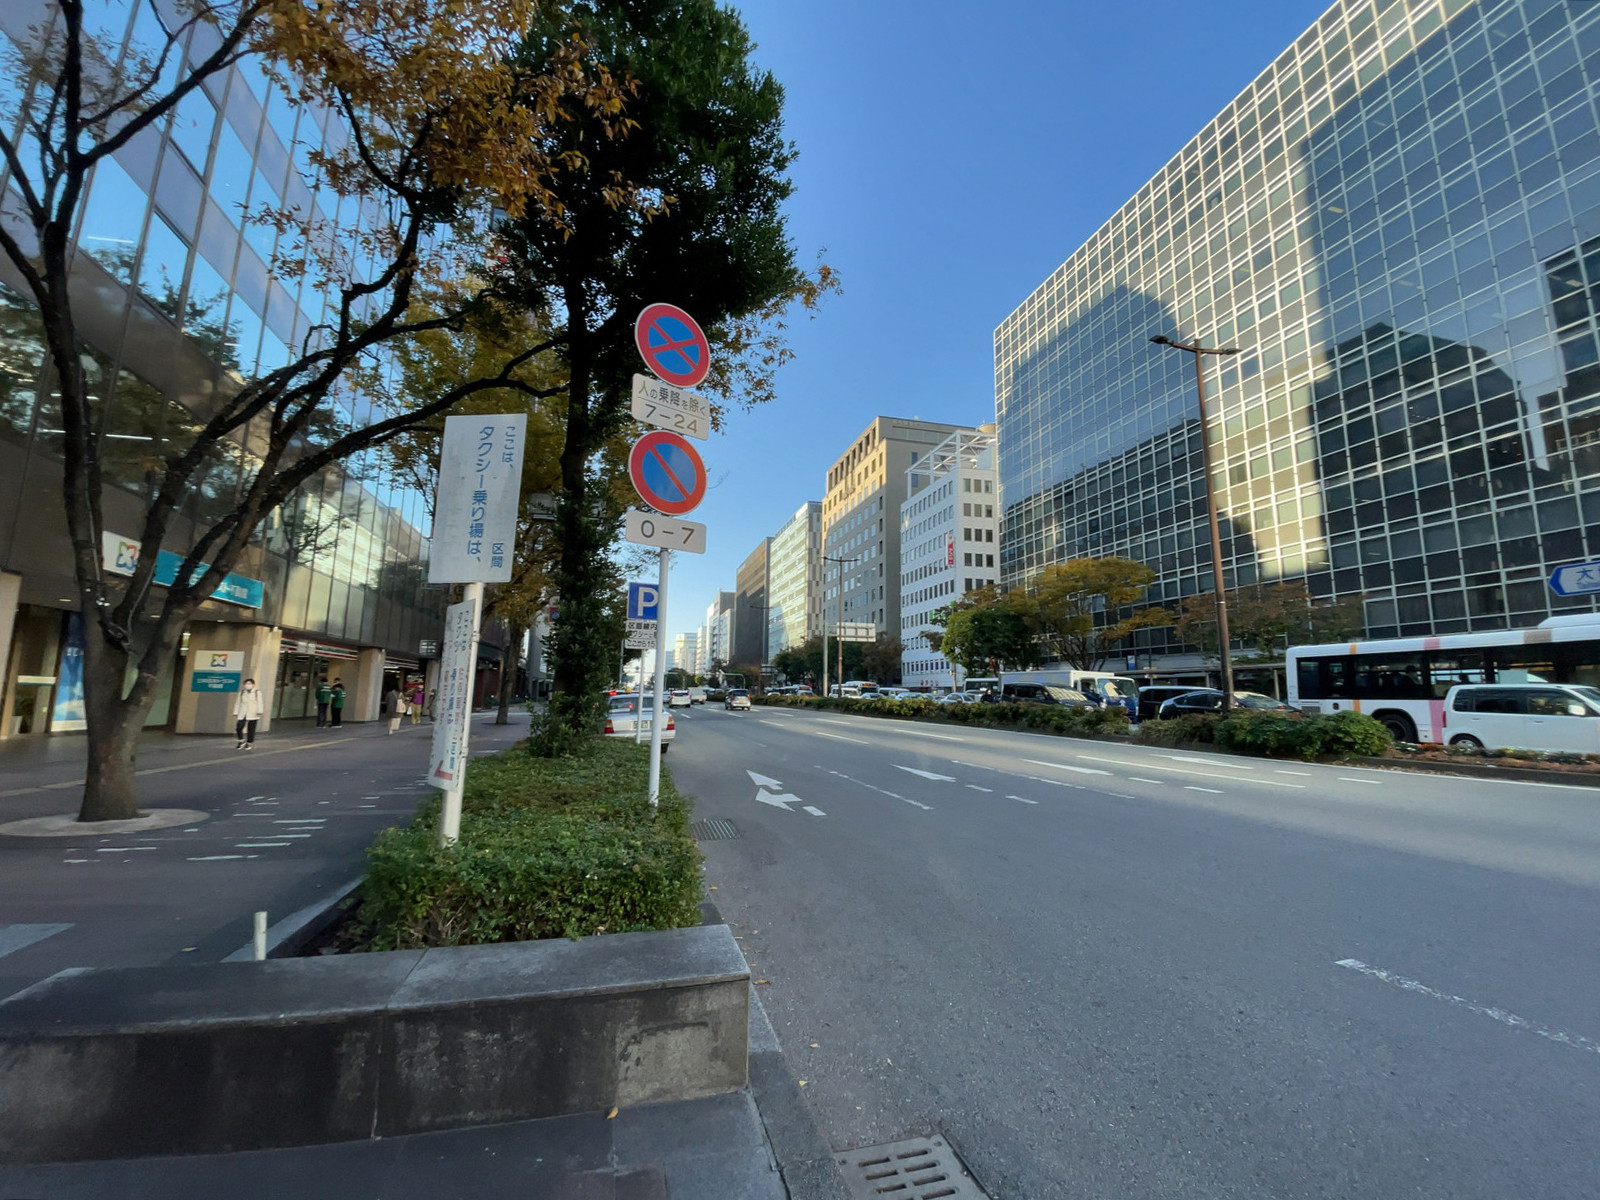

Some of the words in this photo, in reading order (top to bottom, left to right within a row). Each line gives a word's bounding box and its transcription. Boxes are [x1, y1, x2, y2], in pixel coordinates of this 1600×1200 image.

[638, 380, 706, 417] 人の乗降を除く
[491, 542, 504, 569] 区間
[637, 586, 659, 617] P
